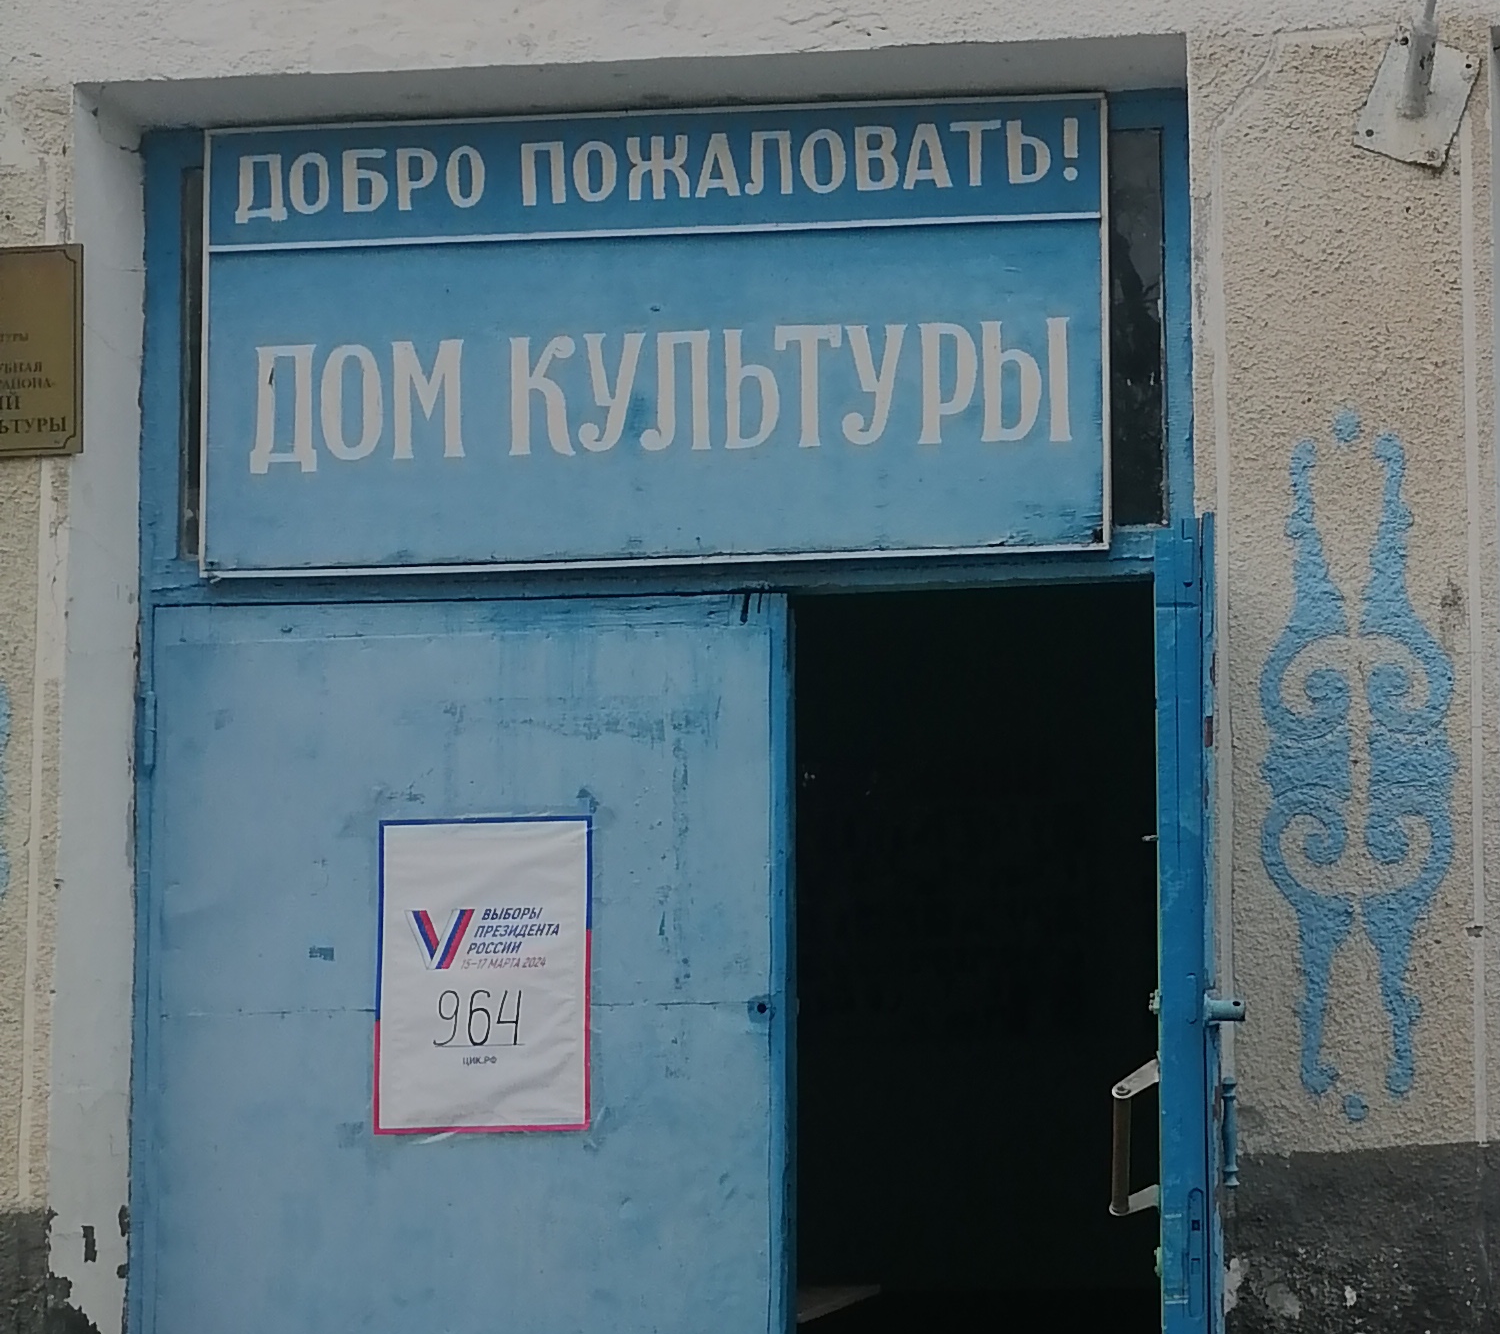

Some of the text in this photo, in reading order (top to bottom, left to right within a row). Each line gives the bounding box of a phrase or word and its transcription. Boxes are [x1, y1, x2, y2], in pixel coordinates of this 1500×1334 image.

[235, 117, 1080, 224] ДОБРО ПОЖАЛОВАТЬ!
[249, 315, 1073, 474] ДОМ КУЛЬТУРЫ
[482, 907, 543, 921] ВЫБОРЫ
[474, 923, 560, 939] ПРЕЗИДЕНТА
[467, 941, 522, 955] РОССИИ
[488, 957, 520, 969] МАРТА
[522, 956, 547, 968] 2024
[433, 989, 522, 1046] 964
[462, 1056, 498, 1066] ЦИК.РФ
